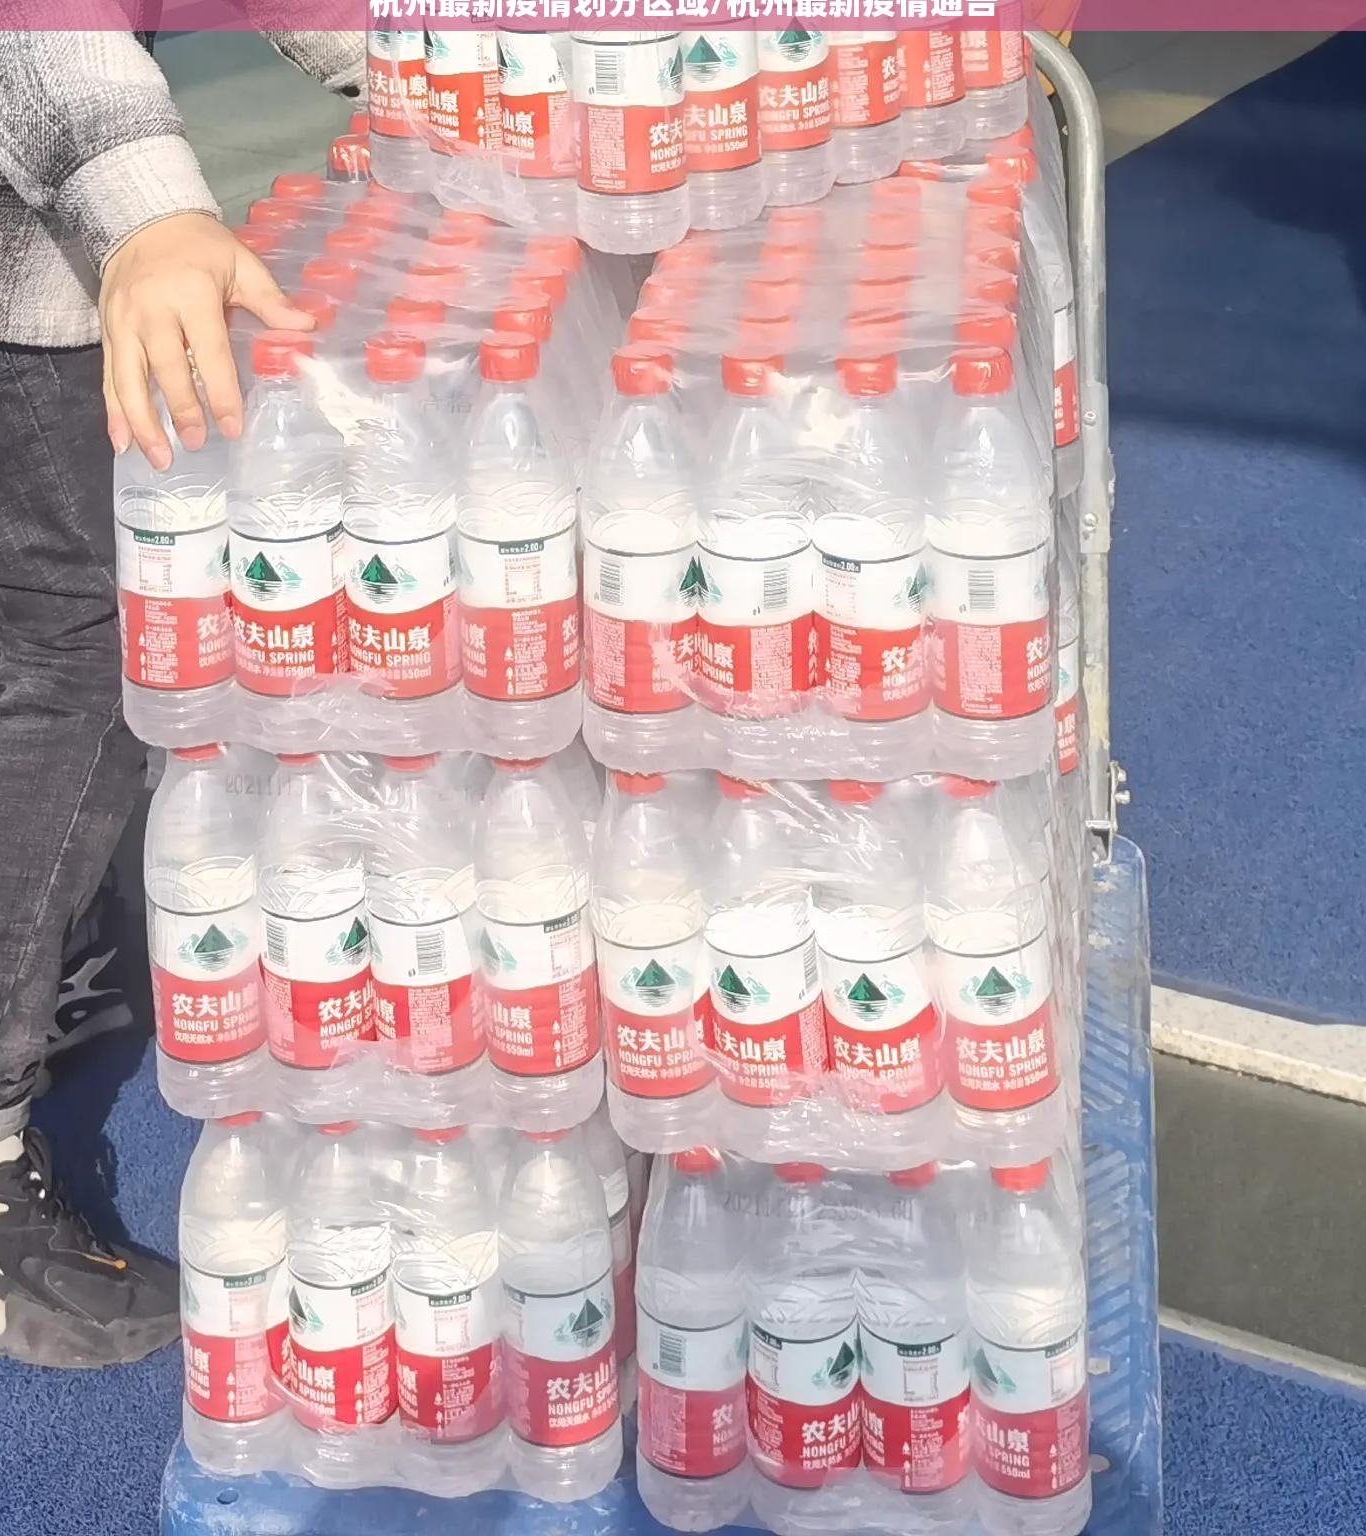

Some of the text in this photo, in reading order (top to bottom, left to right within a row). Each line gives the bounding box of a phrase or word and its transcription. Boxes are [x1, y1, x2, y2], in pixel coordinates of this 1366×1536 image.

[759, 77, 828, 107] 农夫山泉
[710, 125, 748, 141] SPRING
[348, 619, 430, 652] 农夫山泉
[269, 648, 315, 664] SPRING
[386, 650, 431, 666] SPRING
[174, 1015, 218, 1032] NONGFU
[320, 1013, 363, 1038] NONGFU
[834, 1034, 922, 1067] 农夫山泉
[956, 1027, 1045, 1065] 农夫山泉
[619, 1049, 662, 1067] NONGFU
[1009, 1053, 1048, 1076] SPRING
[298, 1381, 335, 1403] SPRING
[548, 1398, 594, 1416] NONGFU
[803, 1436, 846, 1457] NONGFU
